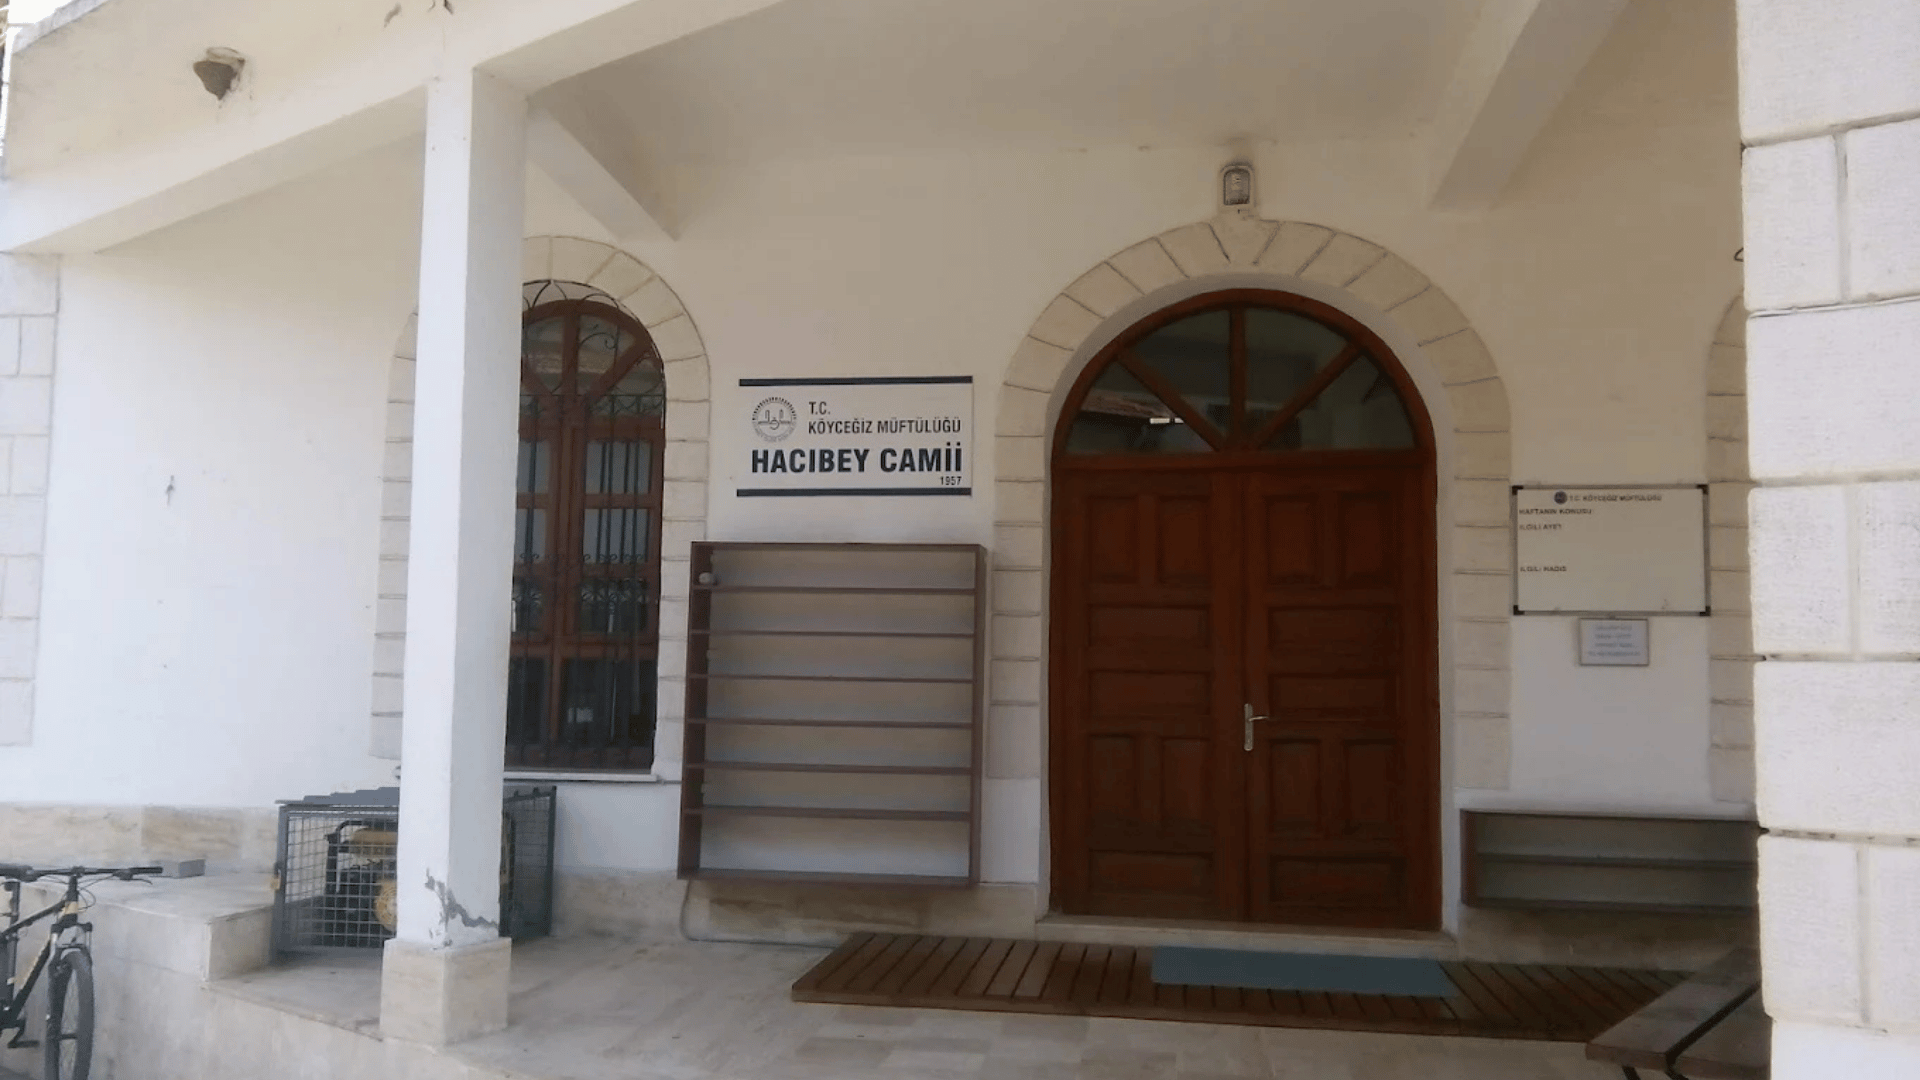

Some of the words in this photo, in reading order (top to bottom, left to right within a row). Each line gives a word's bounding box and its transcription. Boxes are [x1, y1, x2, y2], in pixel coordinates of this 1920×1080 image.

[808, 401, 831, 415] T.C.
[808, 418, 873, 434] KÖYCEĞİZ
[877, 416, 961, 433] MÜFTÜLÜĞÜ
[752, 449, 870, 473] HACIBEY
[880, 442, 962, 472] CAMİİ
[940, 476, 962, 486] 1957
